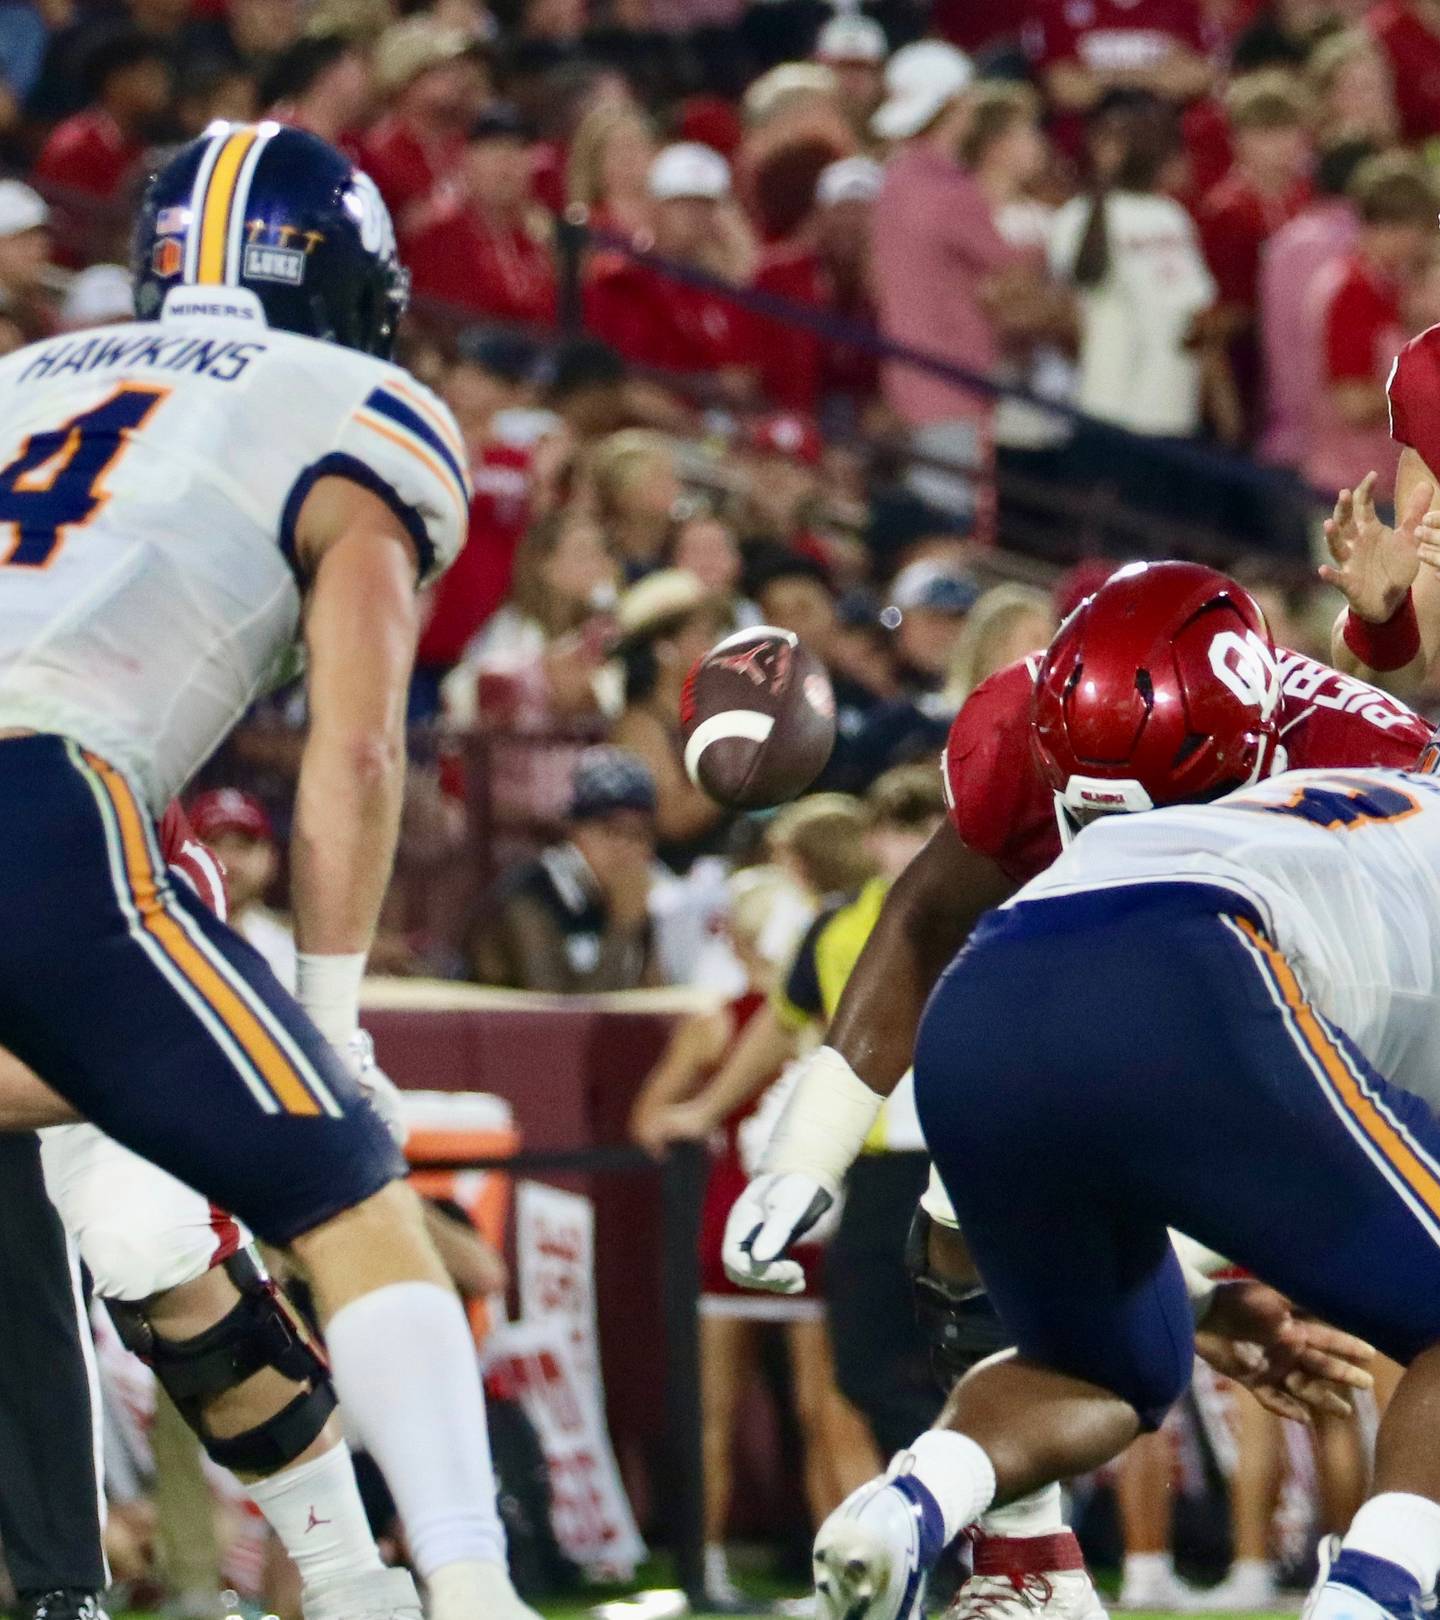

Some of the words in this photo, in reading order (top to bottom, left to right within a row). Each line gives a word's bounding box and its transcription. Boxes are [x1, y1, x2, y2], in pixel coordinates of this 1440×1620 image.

[170, 303, 254, 320] MINERS
[16, 334, 268, 383] HAWKINS
[0, 378, 176, 569] 4
